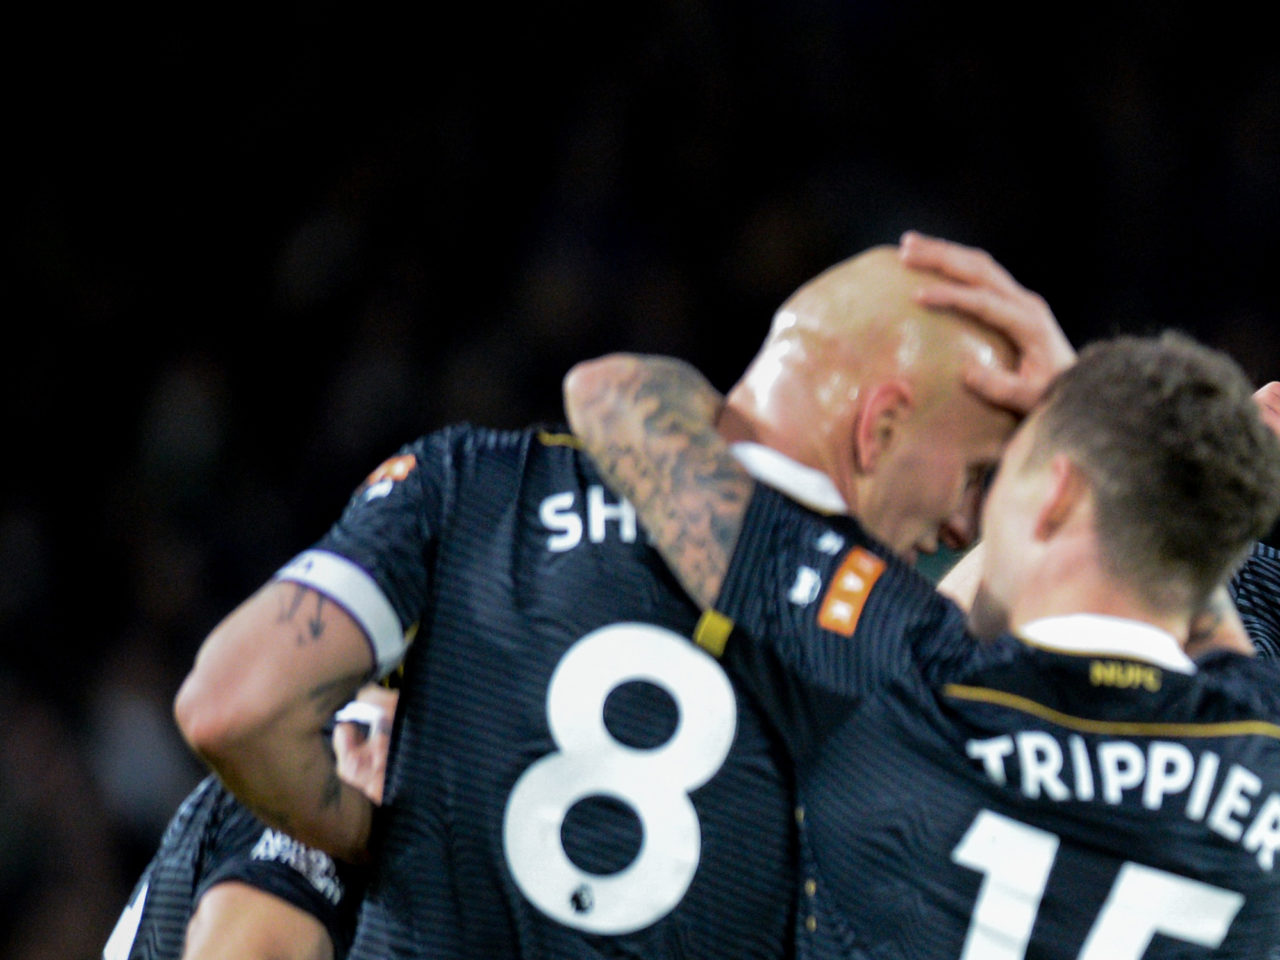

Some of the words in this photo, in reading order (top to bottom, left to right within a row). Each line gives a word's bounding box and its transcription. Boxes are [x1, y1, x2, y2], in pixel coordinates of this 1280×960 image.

[539, 484, 638, 553] SH
[1089, 660, 1162, 692] NUFC
[503, 622, 737, 935] 8
